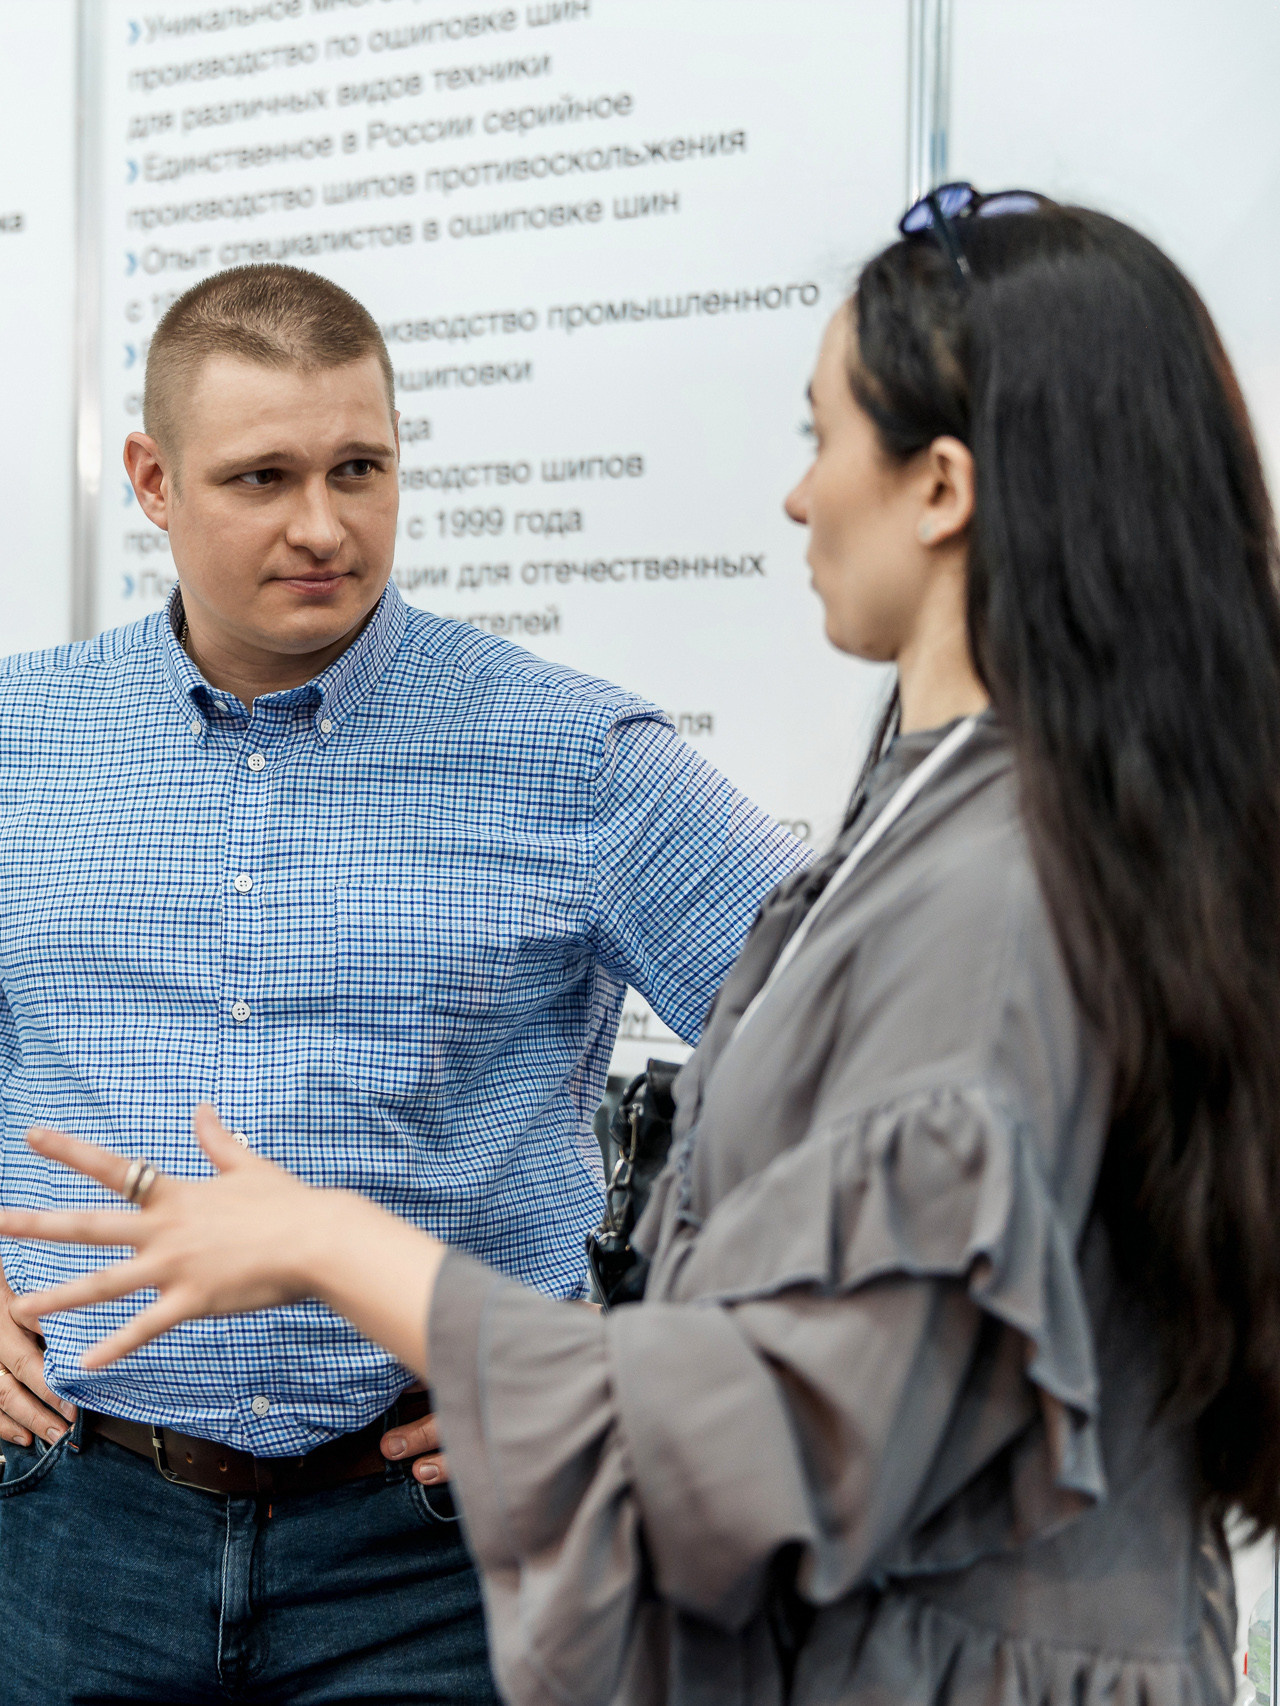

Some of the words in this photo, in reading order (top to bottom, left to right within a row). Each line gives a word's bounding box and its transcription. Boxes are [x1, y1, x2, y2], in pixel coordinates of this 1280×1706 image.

[128, 42, 317, 92] производство
[325, 35, 361, 60] по
[367, 8, 518, 52] ошиповке
[526, 0, 590, 27] шин
[144, 0, 303, 43] Уникальное
[127, 111, 175, 141] для
[182, 89, 329, 134] различных
[336, 74, 422, 107] видов
[432, 54, 551, 91] техники
[142, 134, 333, 183] Единственное
[342, 131, 358, 154] в
[367, 115, 474, 149] России
[483, 92, 634, 134] серийное
[128, 185, 316, 230] производство
[322, 172, 416, 205] шипов
[425, 129, 747, 195] противоскольжения
[141, 244, 212, 275] Опыт
[219, 222, 414, 266] специалистов
[423, 219, 439, 242] в
[448, 200, 603, 239] ошиповке
[611, 191, 681, 221] шин
[384, 308, 537, 345] изводство
[547, 280, 821, 336] промышленного
[395, 358, 533, 392] шиповки
[399, 456, 533, 490] зводство
[542, 453, 644, 482] шипов
[408, 517, 423, 540] с
[436, 507, 505, 538] 1999
[514, 507, 583, 538] года
[457, 561, 511, 592] для
[520, 551, 768, 586] отечественных
